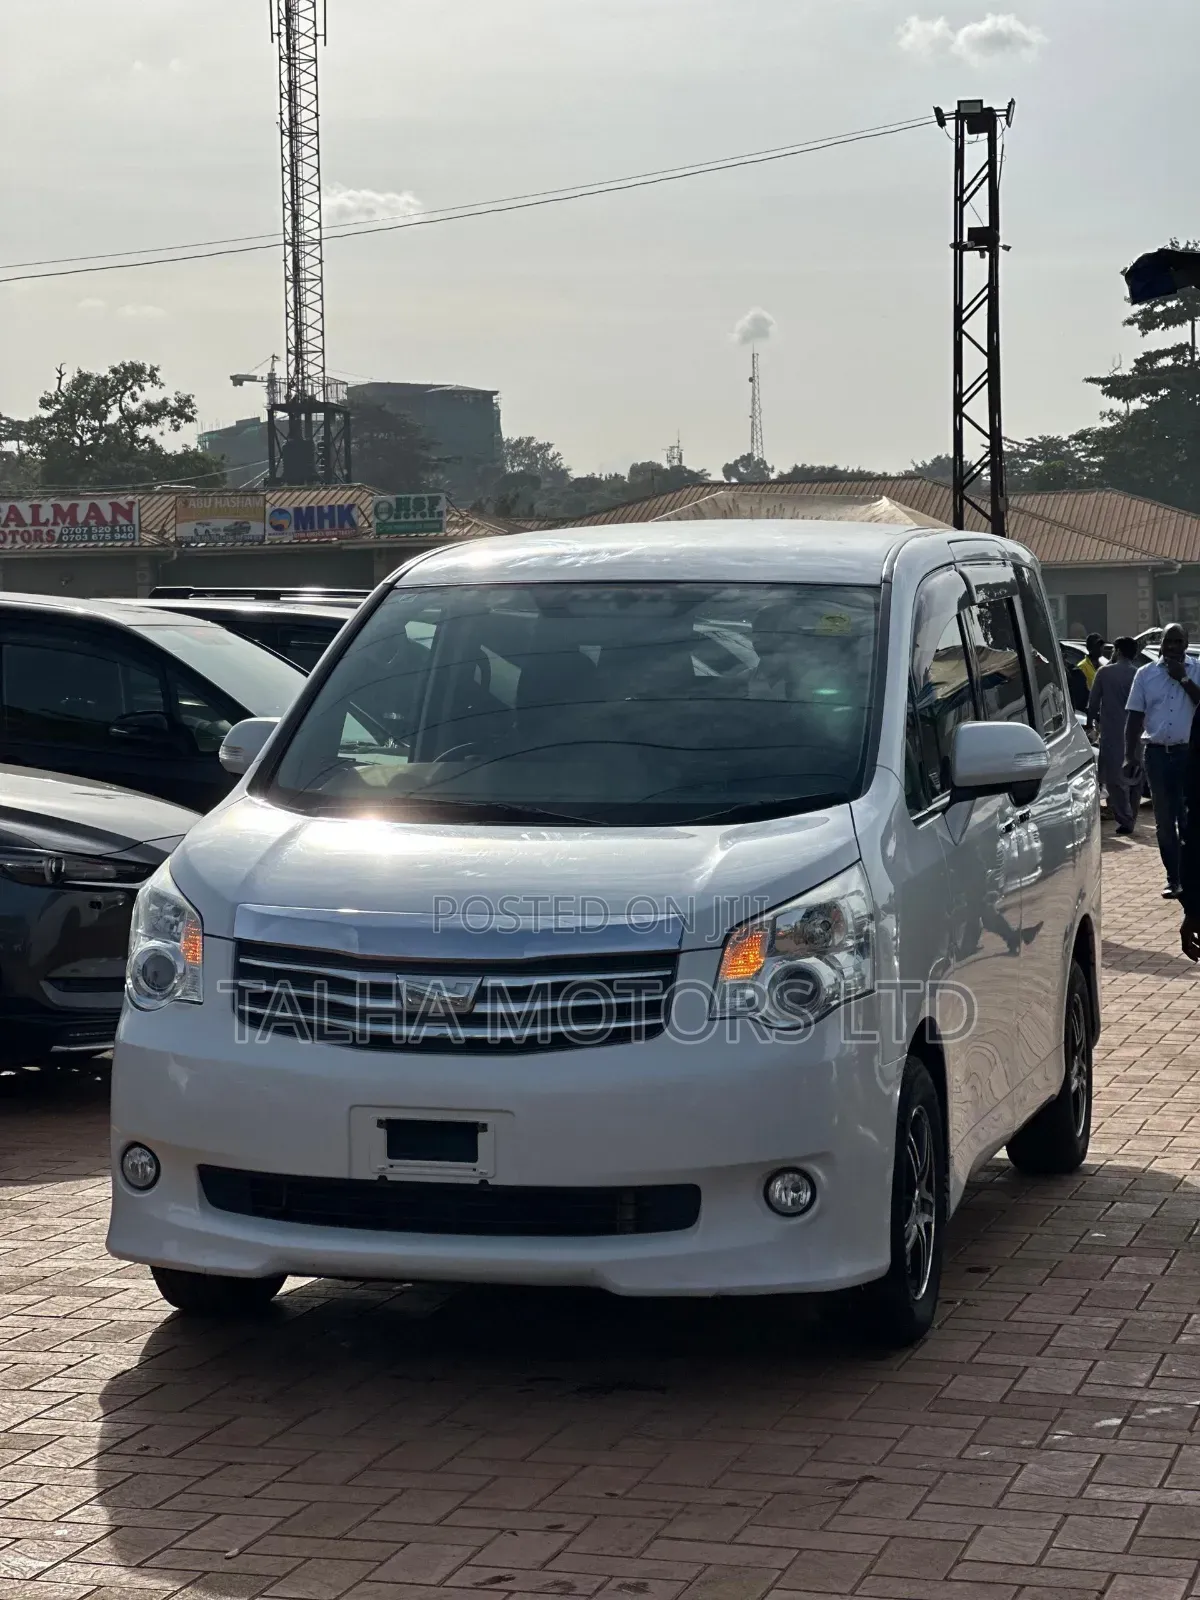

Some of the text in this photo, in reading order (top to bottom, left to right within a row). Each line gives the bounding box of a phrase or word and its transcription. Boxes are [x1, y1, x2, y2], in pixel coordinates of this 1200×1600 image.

[0, 500, 137, 528] ALMAN
[292, 503, 357, 531] MHK
[62, 525, 134, 535] 0707 520 110
[62, 534, 89, 542] 0703
